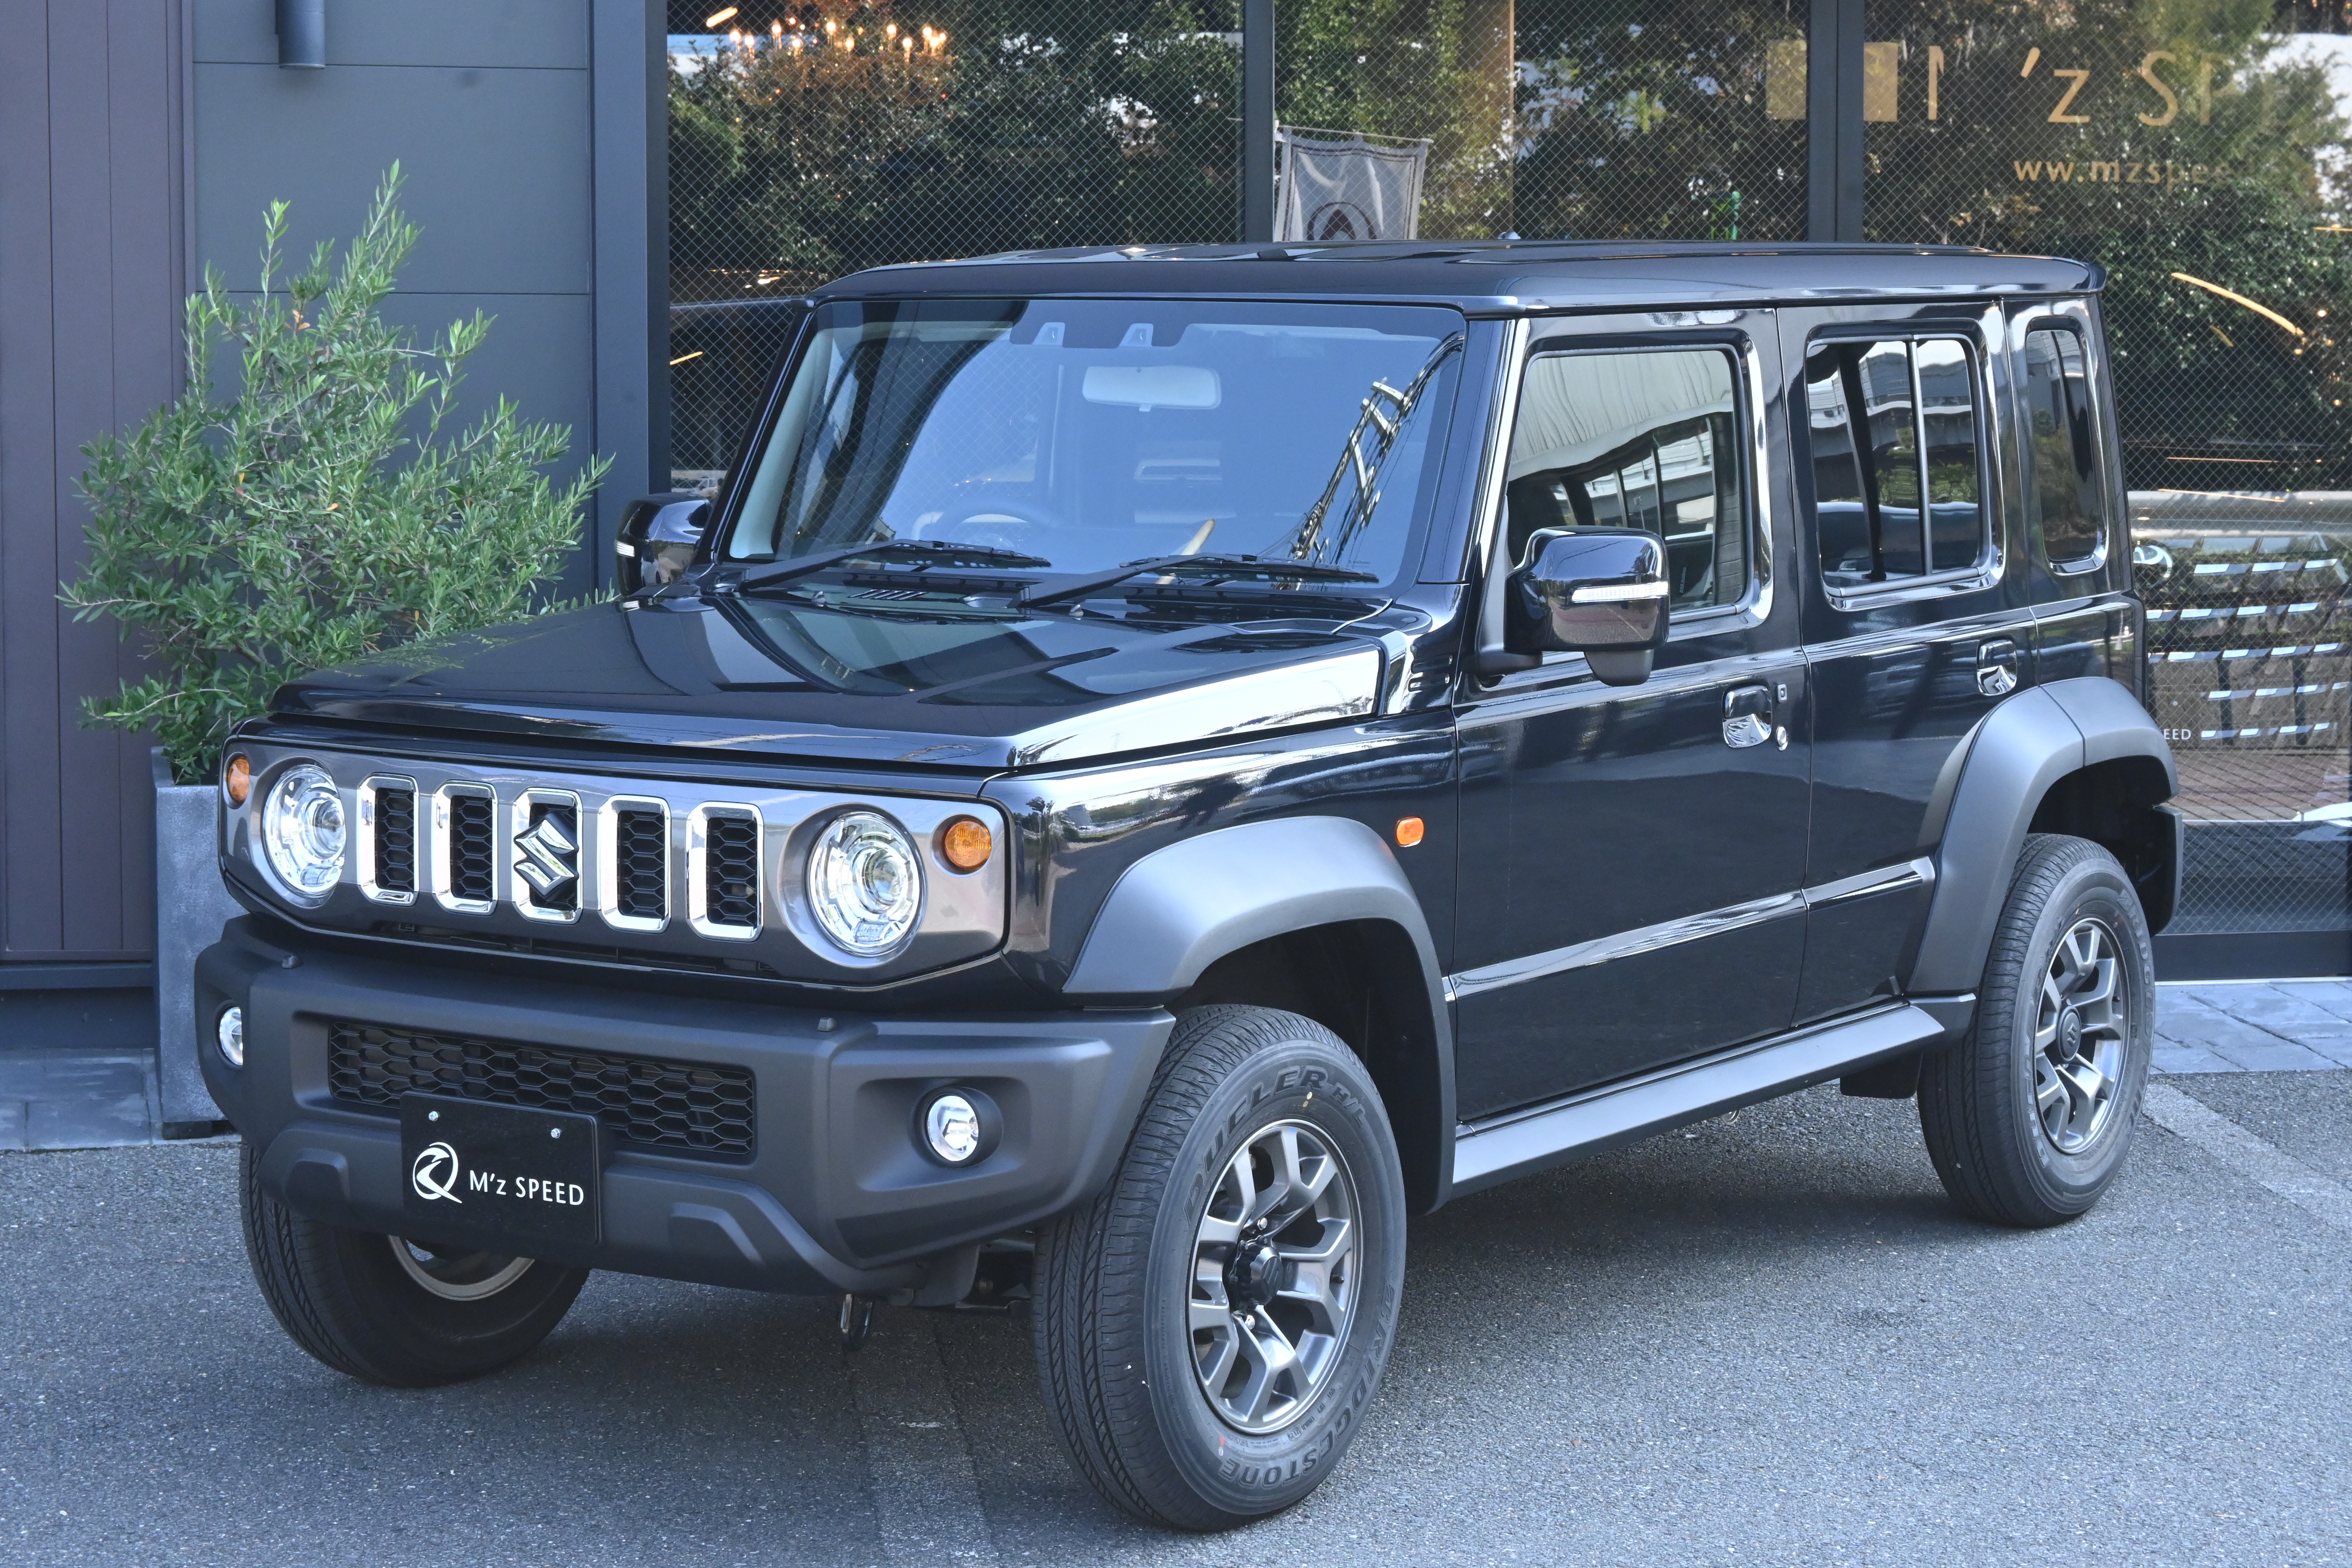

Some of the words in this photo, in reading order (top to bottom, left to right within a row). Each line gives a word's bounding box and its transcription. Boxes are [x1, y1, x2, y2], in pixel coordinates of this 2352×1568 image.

[2163, 729, 2191, 740] EED
[469, 1170, 506, 1195] M'z
[515, 1176, 584, 1206] SPEED
[1218, 1279, 1395, 1489] BRIDGESTONE
